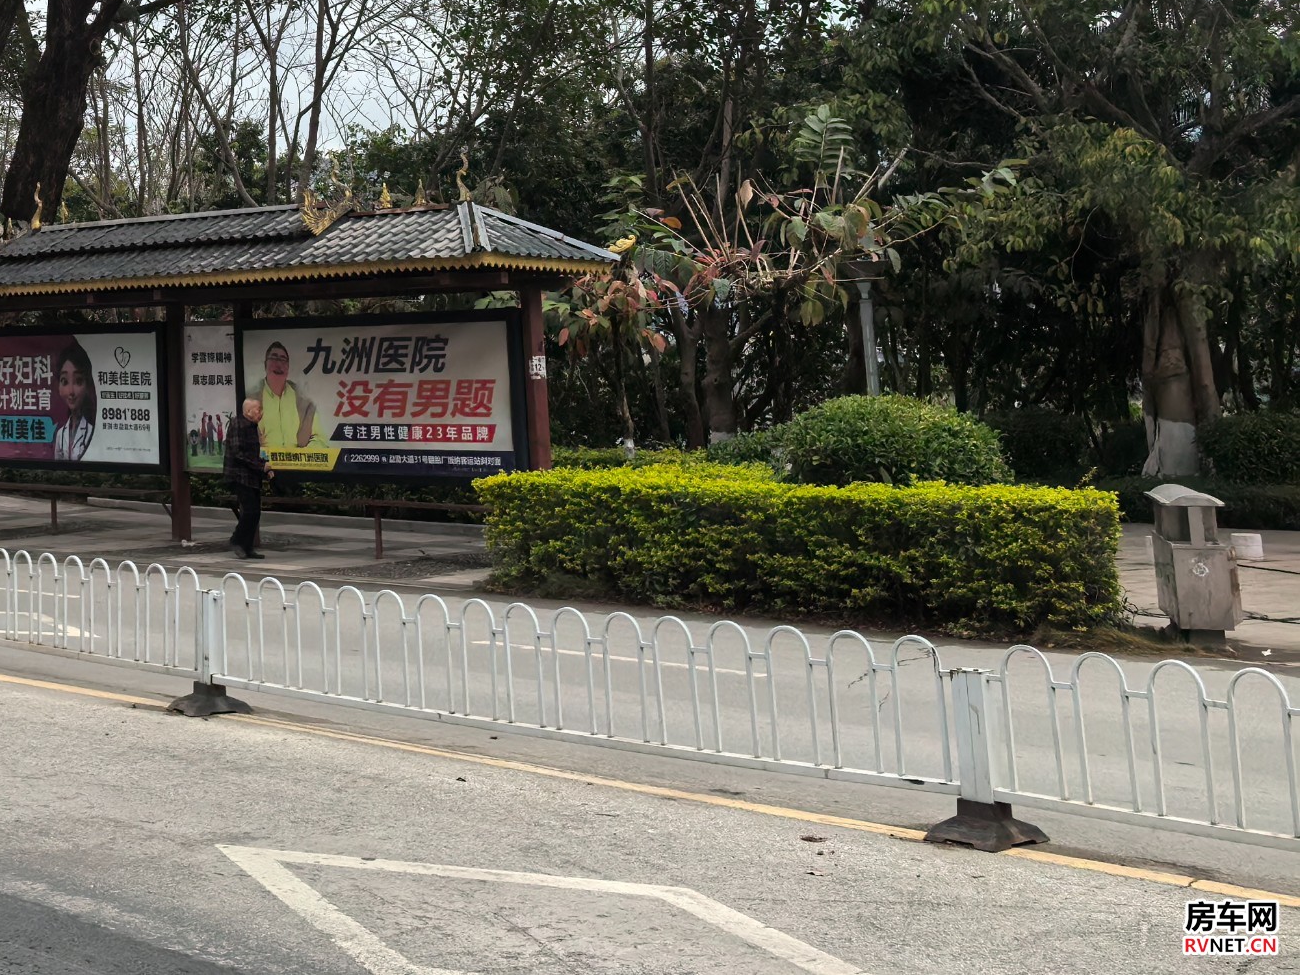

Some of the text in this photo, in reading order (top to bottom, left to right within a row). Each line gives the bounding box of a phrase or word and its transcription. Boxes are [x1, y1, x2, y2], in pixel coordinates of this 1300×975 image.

[191, 351, 232, 363] 学雷锋精神
[303, 334, 449, 375] 九洲医院
[98, 370, 152, 386] 和美佳医院
[192, 374, 233, 386] 展志愿风采
[333, 379, 496, 418] 没有男题
[343, 426, 489, 441] 专注男性健康23年品牌
